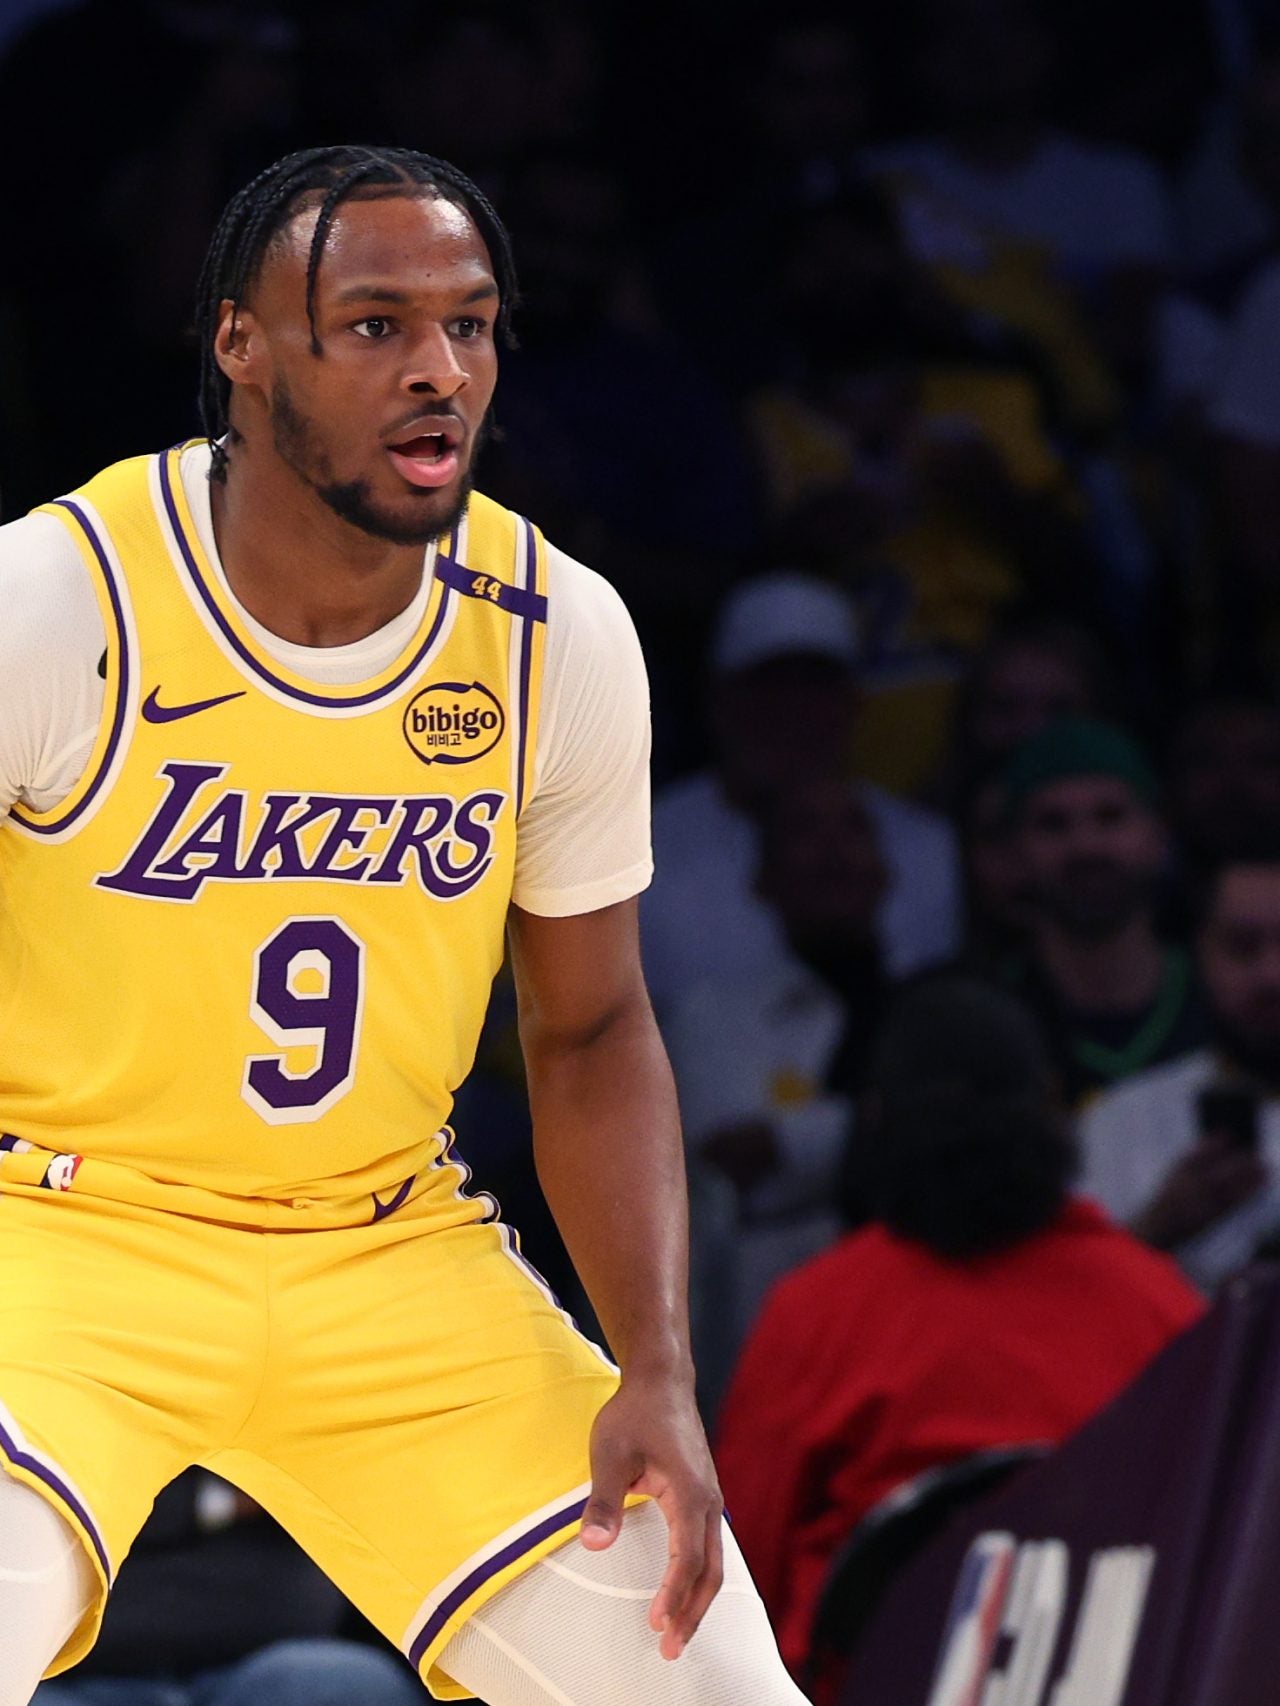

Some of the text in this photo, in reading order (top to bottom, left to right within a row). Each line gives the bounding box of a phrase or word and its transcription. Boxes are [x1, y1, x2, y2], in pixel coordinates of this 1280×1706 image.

[471, 576, 501, 601] 44
[412, 704, 498, 739] bibigo
[426, 732, 462, 747] 비비고
[90, 760, 509, 905] LAKERS
[240, 914, 367, 1126] 9
